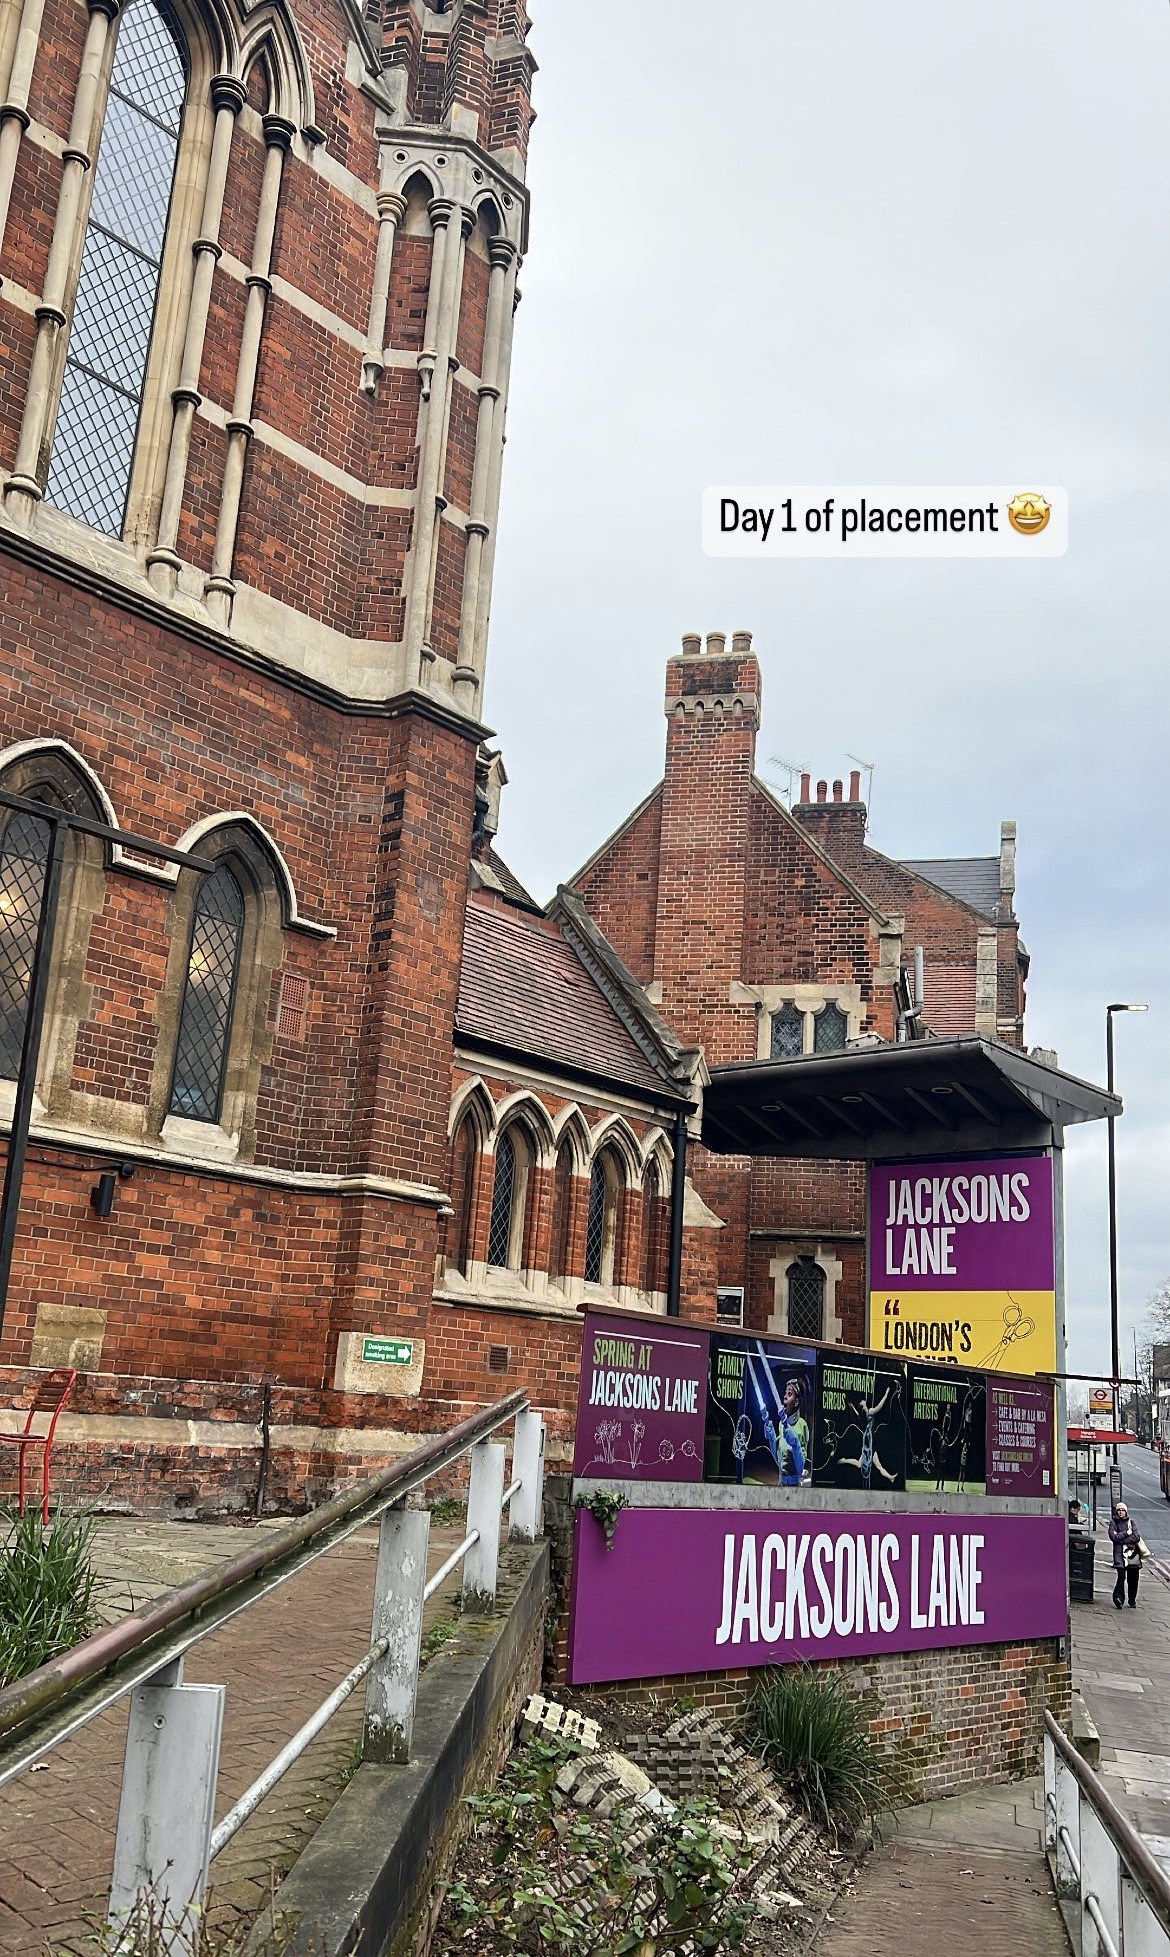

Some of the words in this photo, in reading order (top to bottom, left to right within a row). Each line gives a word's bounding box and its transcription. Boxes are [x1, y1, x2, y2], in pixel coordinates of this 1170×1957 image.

[886, 1172, 1030, 1226] JACKSONS
[886, 1227, 957, 1275] LANE
[368, 1343, 394, 1351] Designated
[593, 1338, 635, 1369] SPRING
[638, 1344, 653, 1371] AT
[717, 1355, 746, 1377] FAMILY
[588, 1370, 661, 1411] JACKSONS
[664, 1377, 699, 1413] LANE
[716, 1378, 744, 1400] SHOWS
[823, 1369, 875, 1394] CONTEMPORARY
[913, 1381, 958, 1404] INTERNATIONAL
[822, 1391, 846, 1412] CIRCUS
[913, 1402, 939, 1420] ARTISTS
[998, 1420, 1013, 1432] EVENTS
[1018, 1422, 1035, 1435] CATERING
[998, 1434, 1015, 1446] CLASSES
[1020, 1436, 1036, 1448] COURSES
[716, 1533, 900, 1645] JACKSONS
[910, 1534, 985, 1629] LANE
